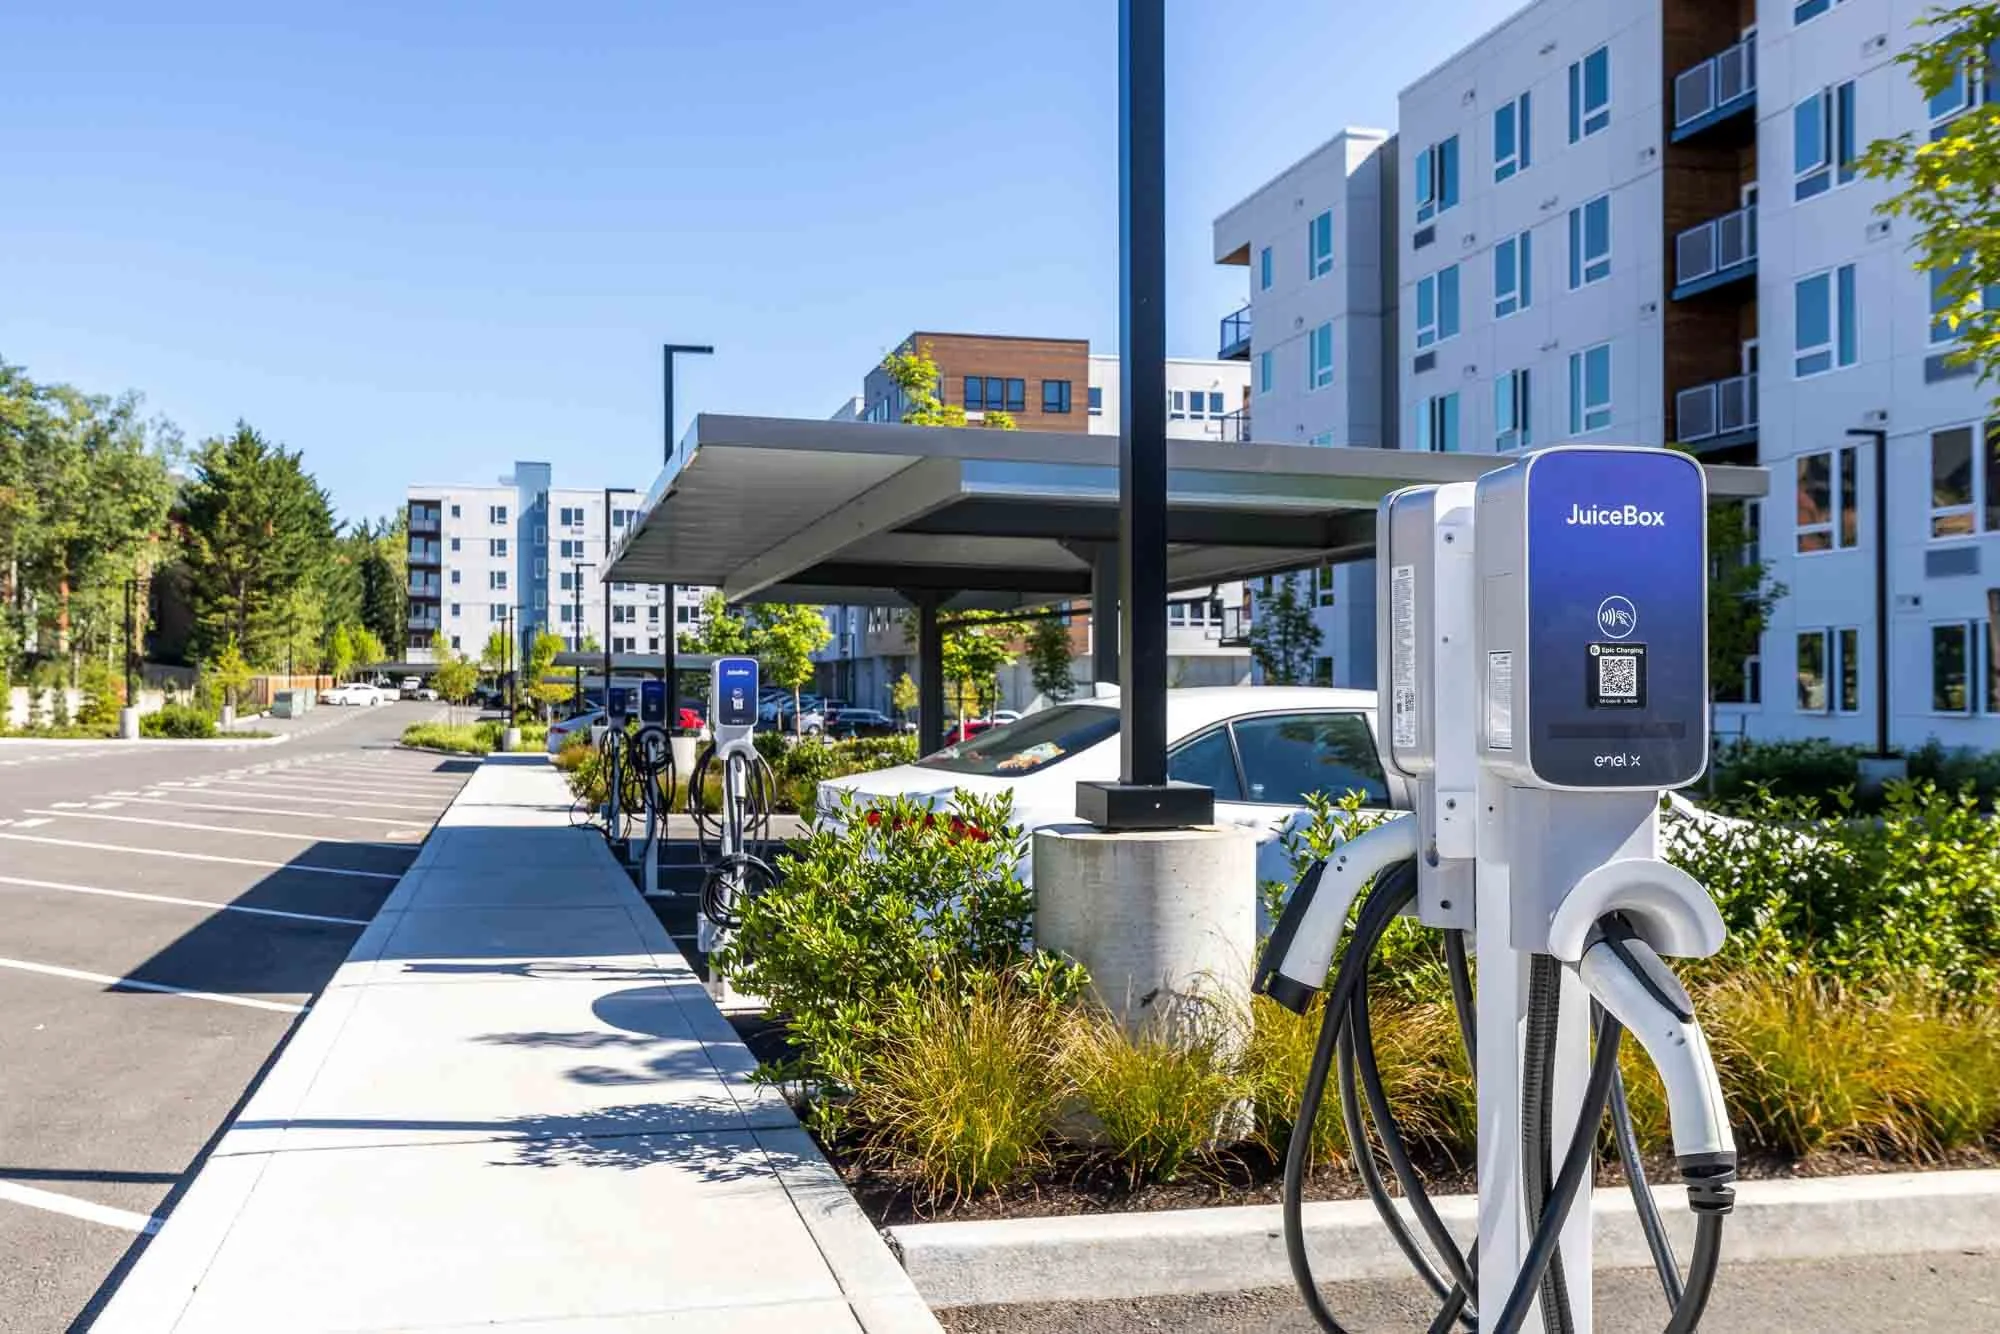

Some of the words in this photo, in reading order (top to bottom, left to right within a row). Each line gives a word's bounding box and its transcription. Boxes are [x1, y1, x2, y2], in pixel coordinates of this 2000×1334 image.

[1566, 503, 1665, 526] JuiceBox
[1616, 647, 1644, 655] Charging
[1594, 752, 1627, 767] enel
